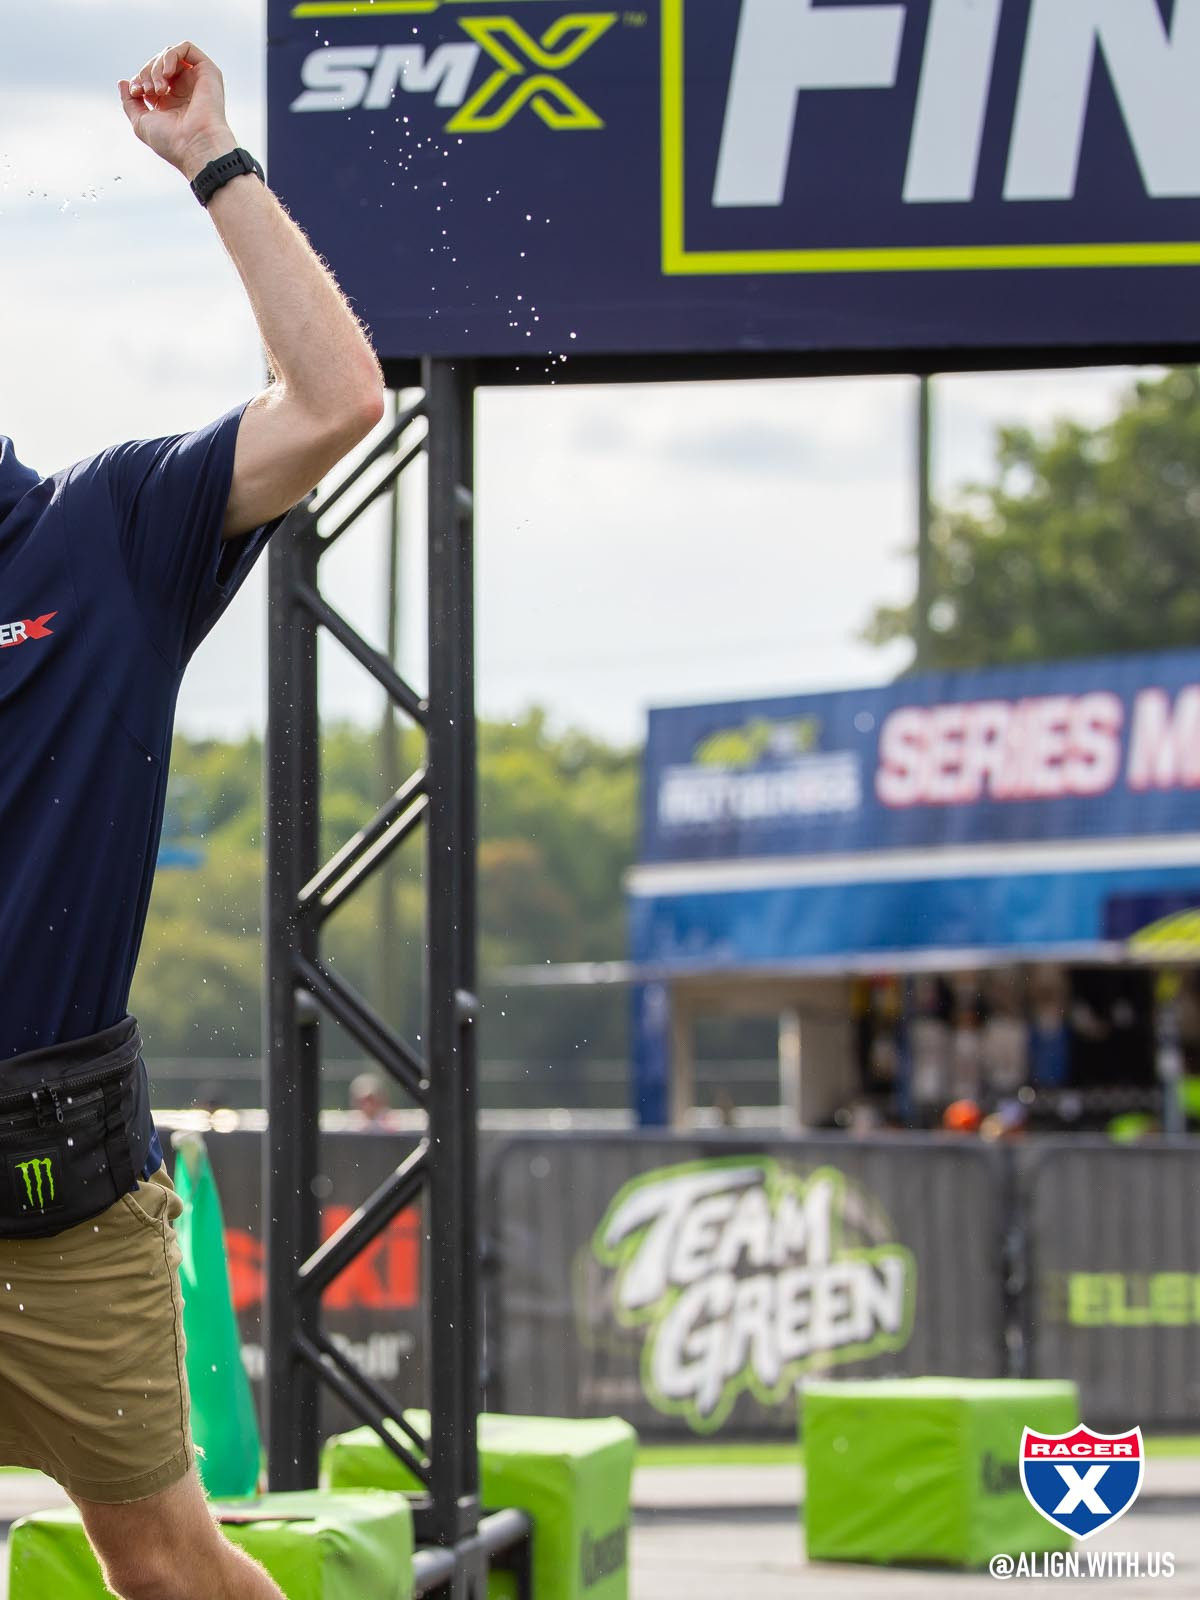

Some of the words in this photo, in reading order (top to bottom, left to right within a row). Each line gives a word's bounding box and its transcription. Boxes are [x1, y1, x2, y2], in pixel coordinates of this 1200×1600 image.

[289, 13, 618, 133] SMX
[875, 690, 1123, 809] SERIES
[605, 1165, 834, 1309] TEAM
[652, 1254, 904, 1415] GREEN
